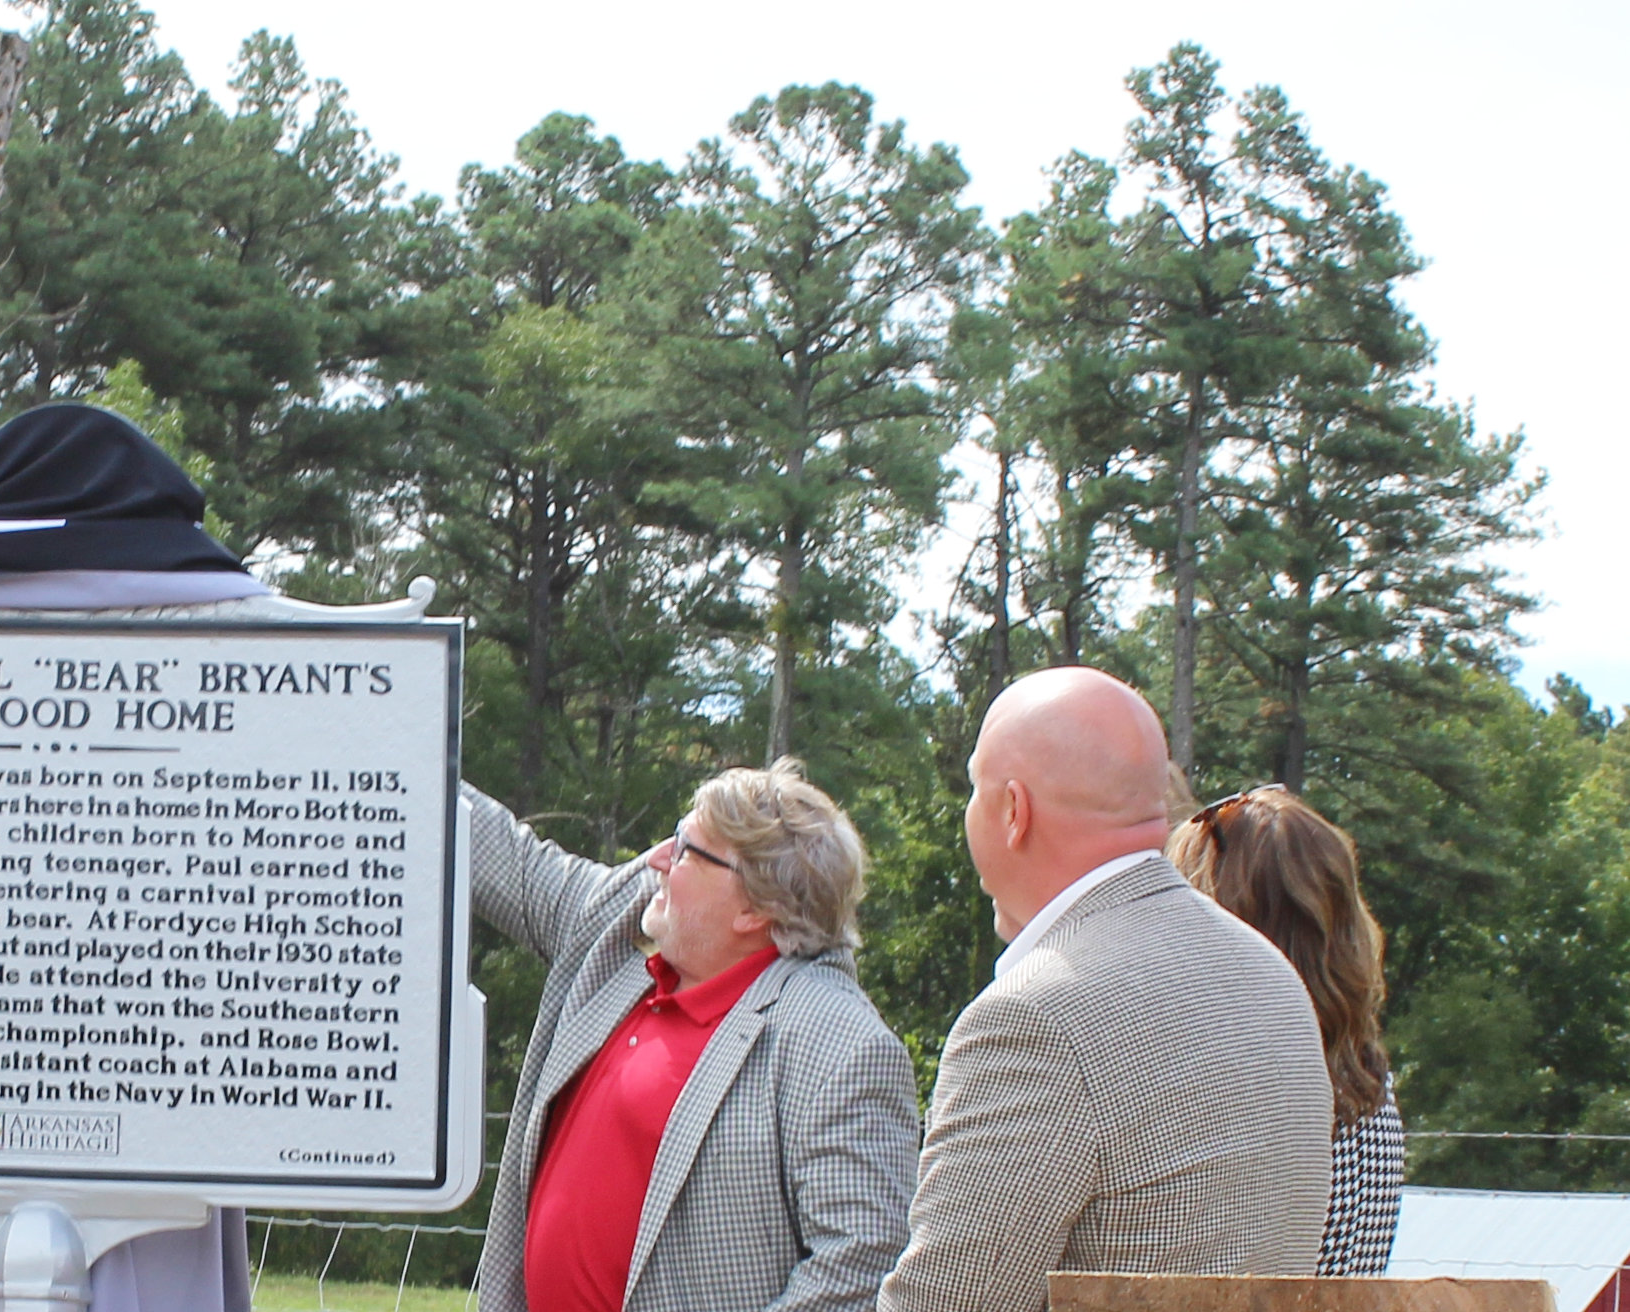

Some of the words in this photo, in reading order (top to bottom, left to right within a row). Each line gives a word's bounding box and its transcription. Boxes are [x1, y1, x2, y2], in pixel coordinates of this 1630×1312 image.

[34, 657, 179, 693] "BEAR"
[199, 661, 393, 696] BRYANT'S
[114, 698, 234, 733] HOME
[39, 764, 103, 788] born
[112, 771, 143, 789] on
[153, 766, 302, 794] September
[311, 769, 339, 793] 11,
[348, 770, 407, 795] 1913,
[24, 793, 83, 816] here
[88, 794, 112, 818] in
[115, 800, 130, 818] a
[134, 795, 200, 819] home
[204, 796, 229, 820] in
[233, 797, 300, 821] Moro
[304, 798, 406, 823] Bottom.
[7, 821, 123, 846] children
[131, 824, 196, 848] born
[205, 824, 233, 848] to
[242, 825, 345, 850] Monroe
[355, 829, 405, 852] and
[43, 850, 172, 879] teenager,
[185, 853, 242, 877] Paul
[250, 857, 349, 880] earned
[359, 857, 404, 881] the
[116, 886, 130, 903] a
[140, 882, 255, 906] carnival
[264, 885, 403, 911] promotion
[5, 906, 72, 930] bear.
[86, 907, 118, 931] At
[122, 909, 236, 939] Fordyce
[243, 912, 307, 943] High
[314, 914, 402, 938] School
[23, 936, 70, 958] and
[75, 936, 164, 963] played
[168, 943, 199, 962] on
[203, 939, 271, 963] their
[275, 941, 333, 965] 1930
[338, 942, 402, 966] state
[29, 964, 152, 990] attended
[161, 967, 206, 991] the
[216, 968, 363, 997] University
[372, 973, 401, 996] of
[50, 993, 106, 1016] that
[113, 1000, 165, 1018] won
[171, 995, 214, 1019] the
[220, 997, 399, 1024] Southeastern
[200, 1026, 250, 1049] and
[257, 1026, 318, 1051] Rose
[326, 1029, 399, 1053] Bowl.
[98, 1053, 176, 1077] coach
[183, 1054, 210, 1077] at
[217, 1055, 337, 1081] Alabama
[345, 1059, 397, 1082] and
[36, 1078, 61, 1102] in
[66, 1079, 110, 1103] the
[115, 1080, 185, 1110] Navy
[190, 1082, 215, 1106] in
[220, 1084, 298, 1108] World
[305, 1086, 357, 1110] War
[363, 1088, 392, 1111] II.
[10, 1113, 114, 1133] ARKANSAS
[9, 1131, 113, 1150] HERITAGE
[278, 1148, 396, 1167] (Continued)
